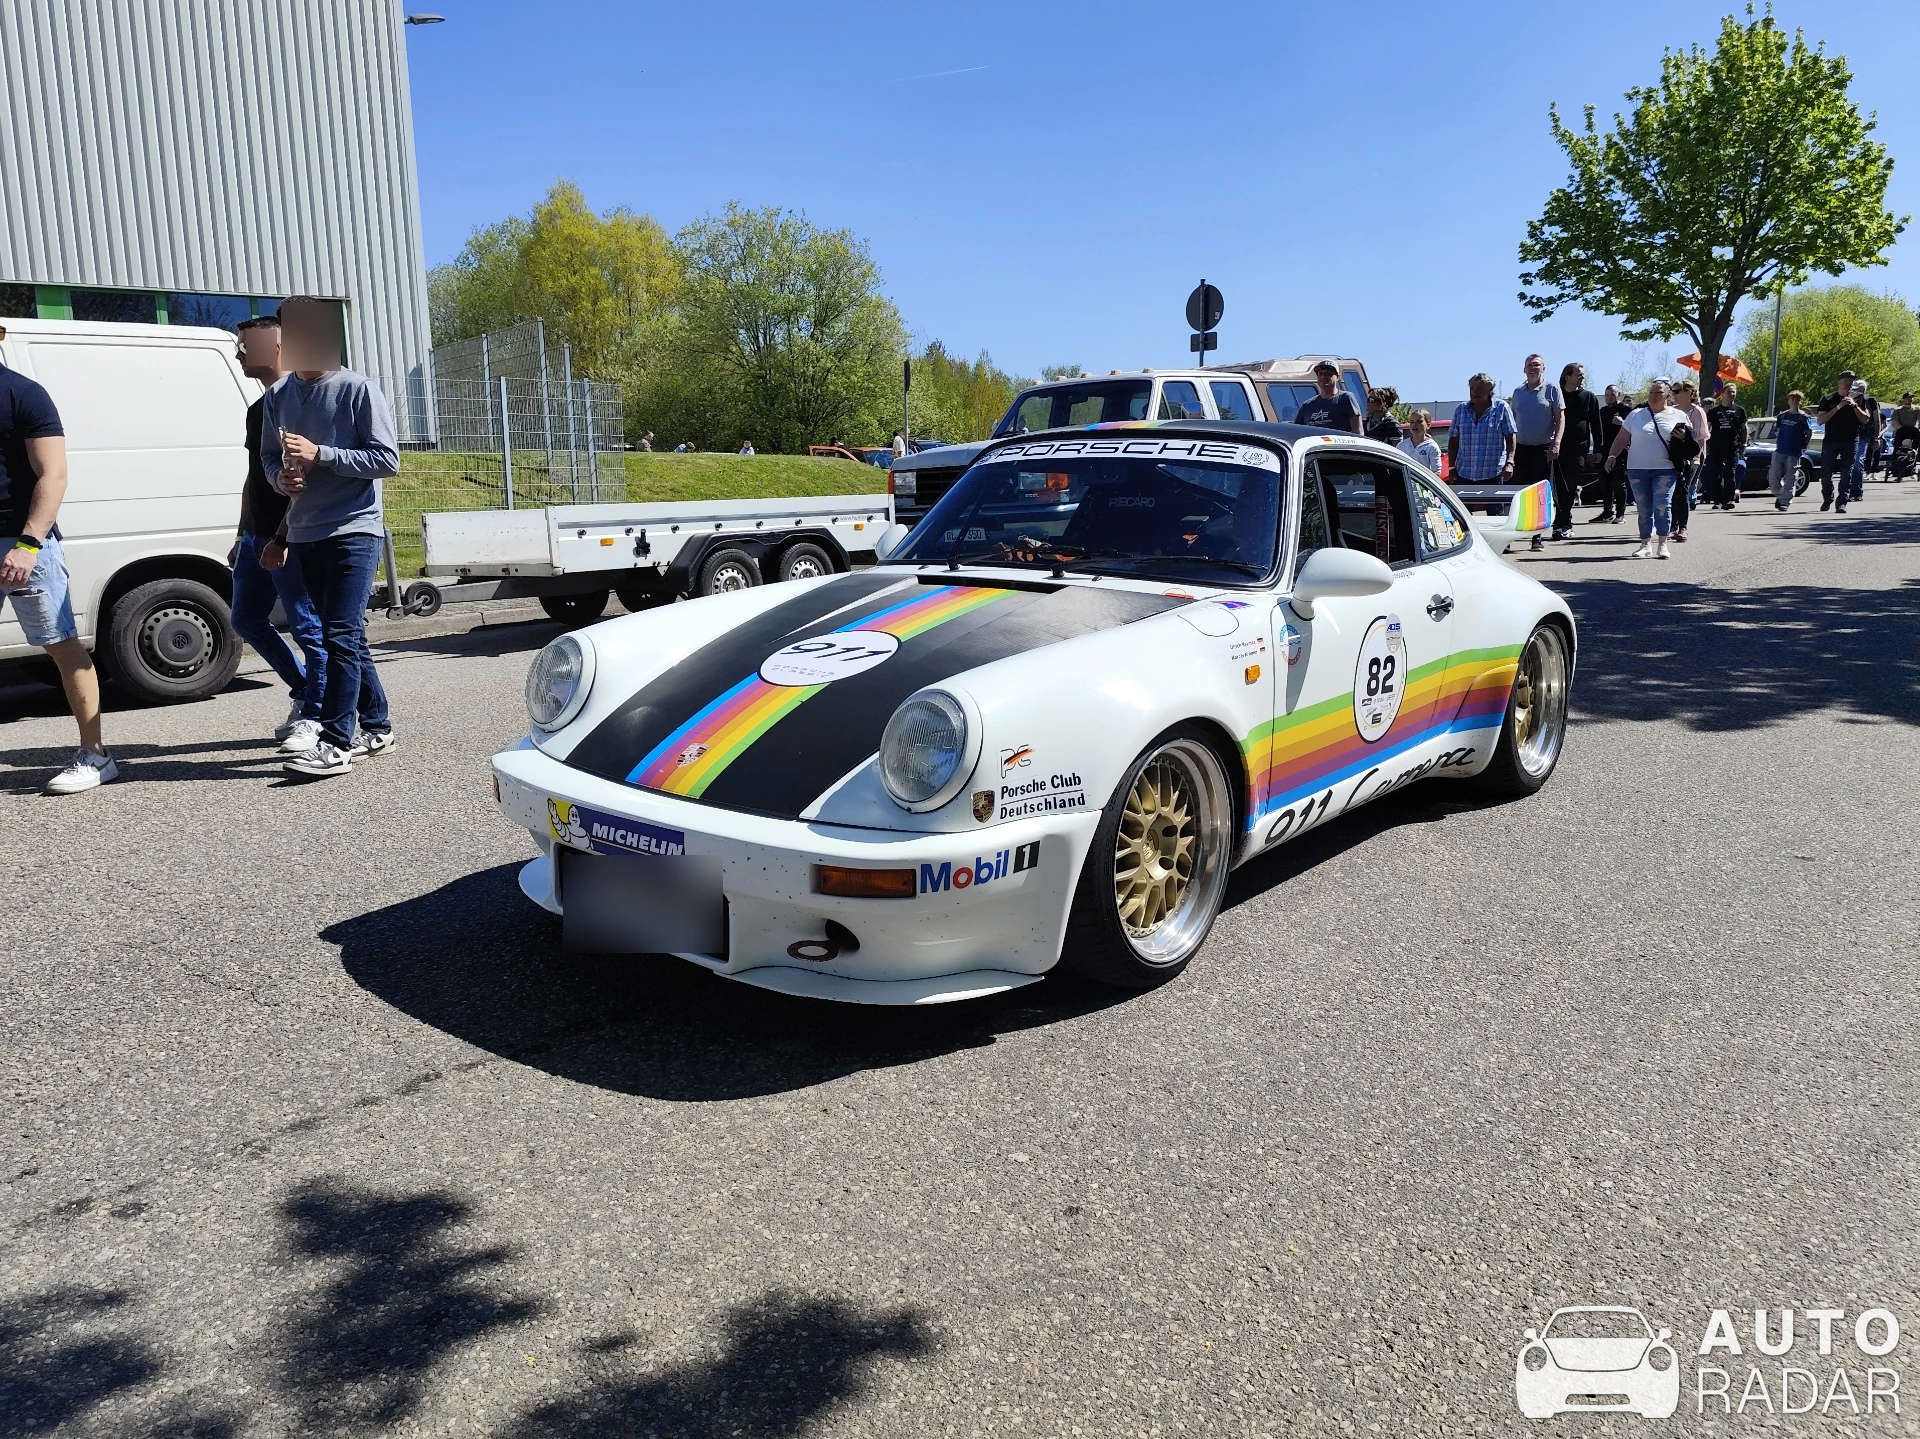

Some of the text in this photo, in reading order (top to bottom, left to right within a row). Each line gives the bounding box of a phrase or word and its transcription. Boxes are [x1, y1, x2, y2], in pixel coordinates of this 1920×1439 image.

[994, 442, 1240, 459] PORSCHE
[1108, 497, 1155, 507] RECARO
[780, 642, 892, 661] 911
[1366, 655, 1396, 697] 82
[1000, 772, 1082, 800] Porsche Club
[1259, 747, 1476, 851] 911 Carrera
[1000, 793, 1086, 820] Deutschland
[591, 822, 684, 855] MICHELIN
[920, 849, 1010, 894] Mobil
